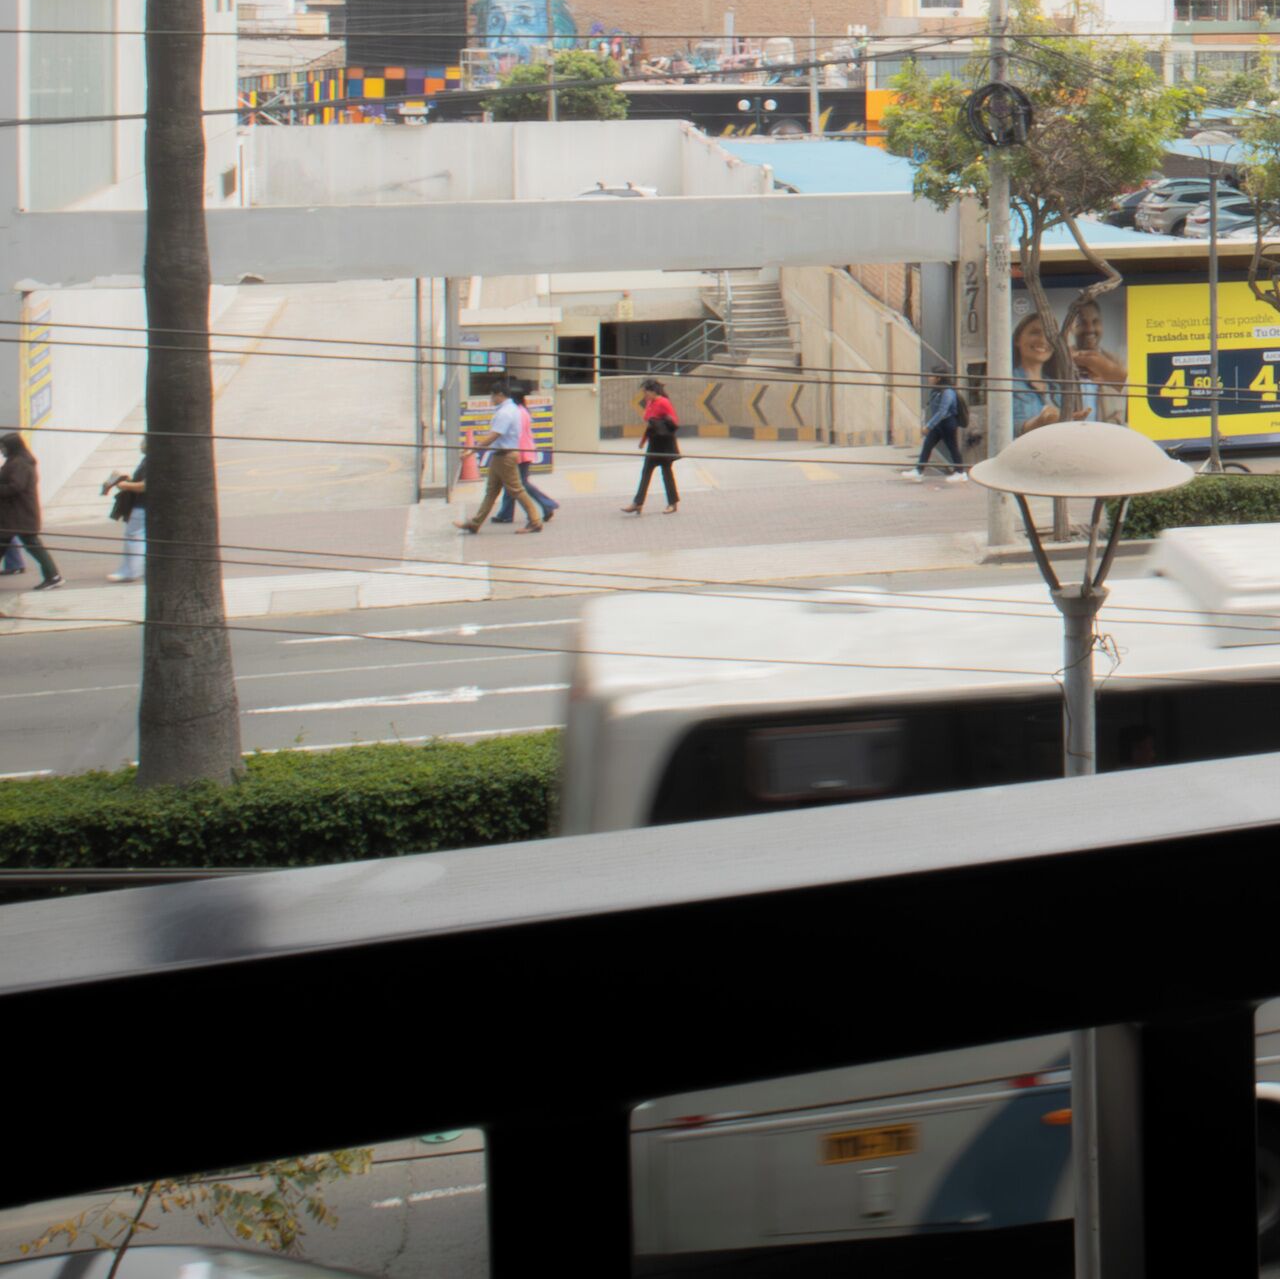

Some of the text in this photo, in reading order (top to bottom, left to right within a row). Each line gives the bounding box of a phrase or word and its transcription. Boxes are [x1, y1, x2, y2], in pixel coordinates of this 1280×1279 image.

[965, 261, 979, 334] 270
[1146, 318, 1165, 328] Ese
[1147, 332, 1188, 342] Traslada
[1190, 332, 1206, 340] tus
[1255, 328, 1268, 337] Tu
